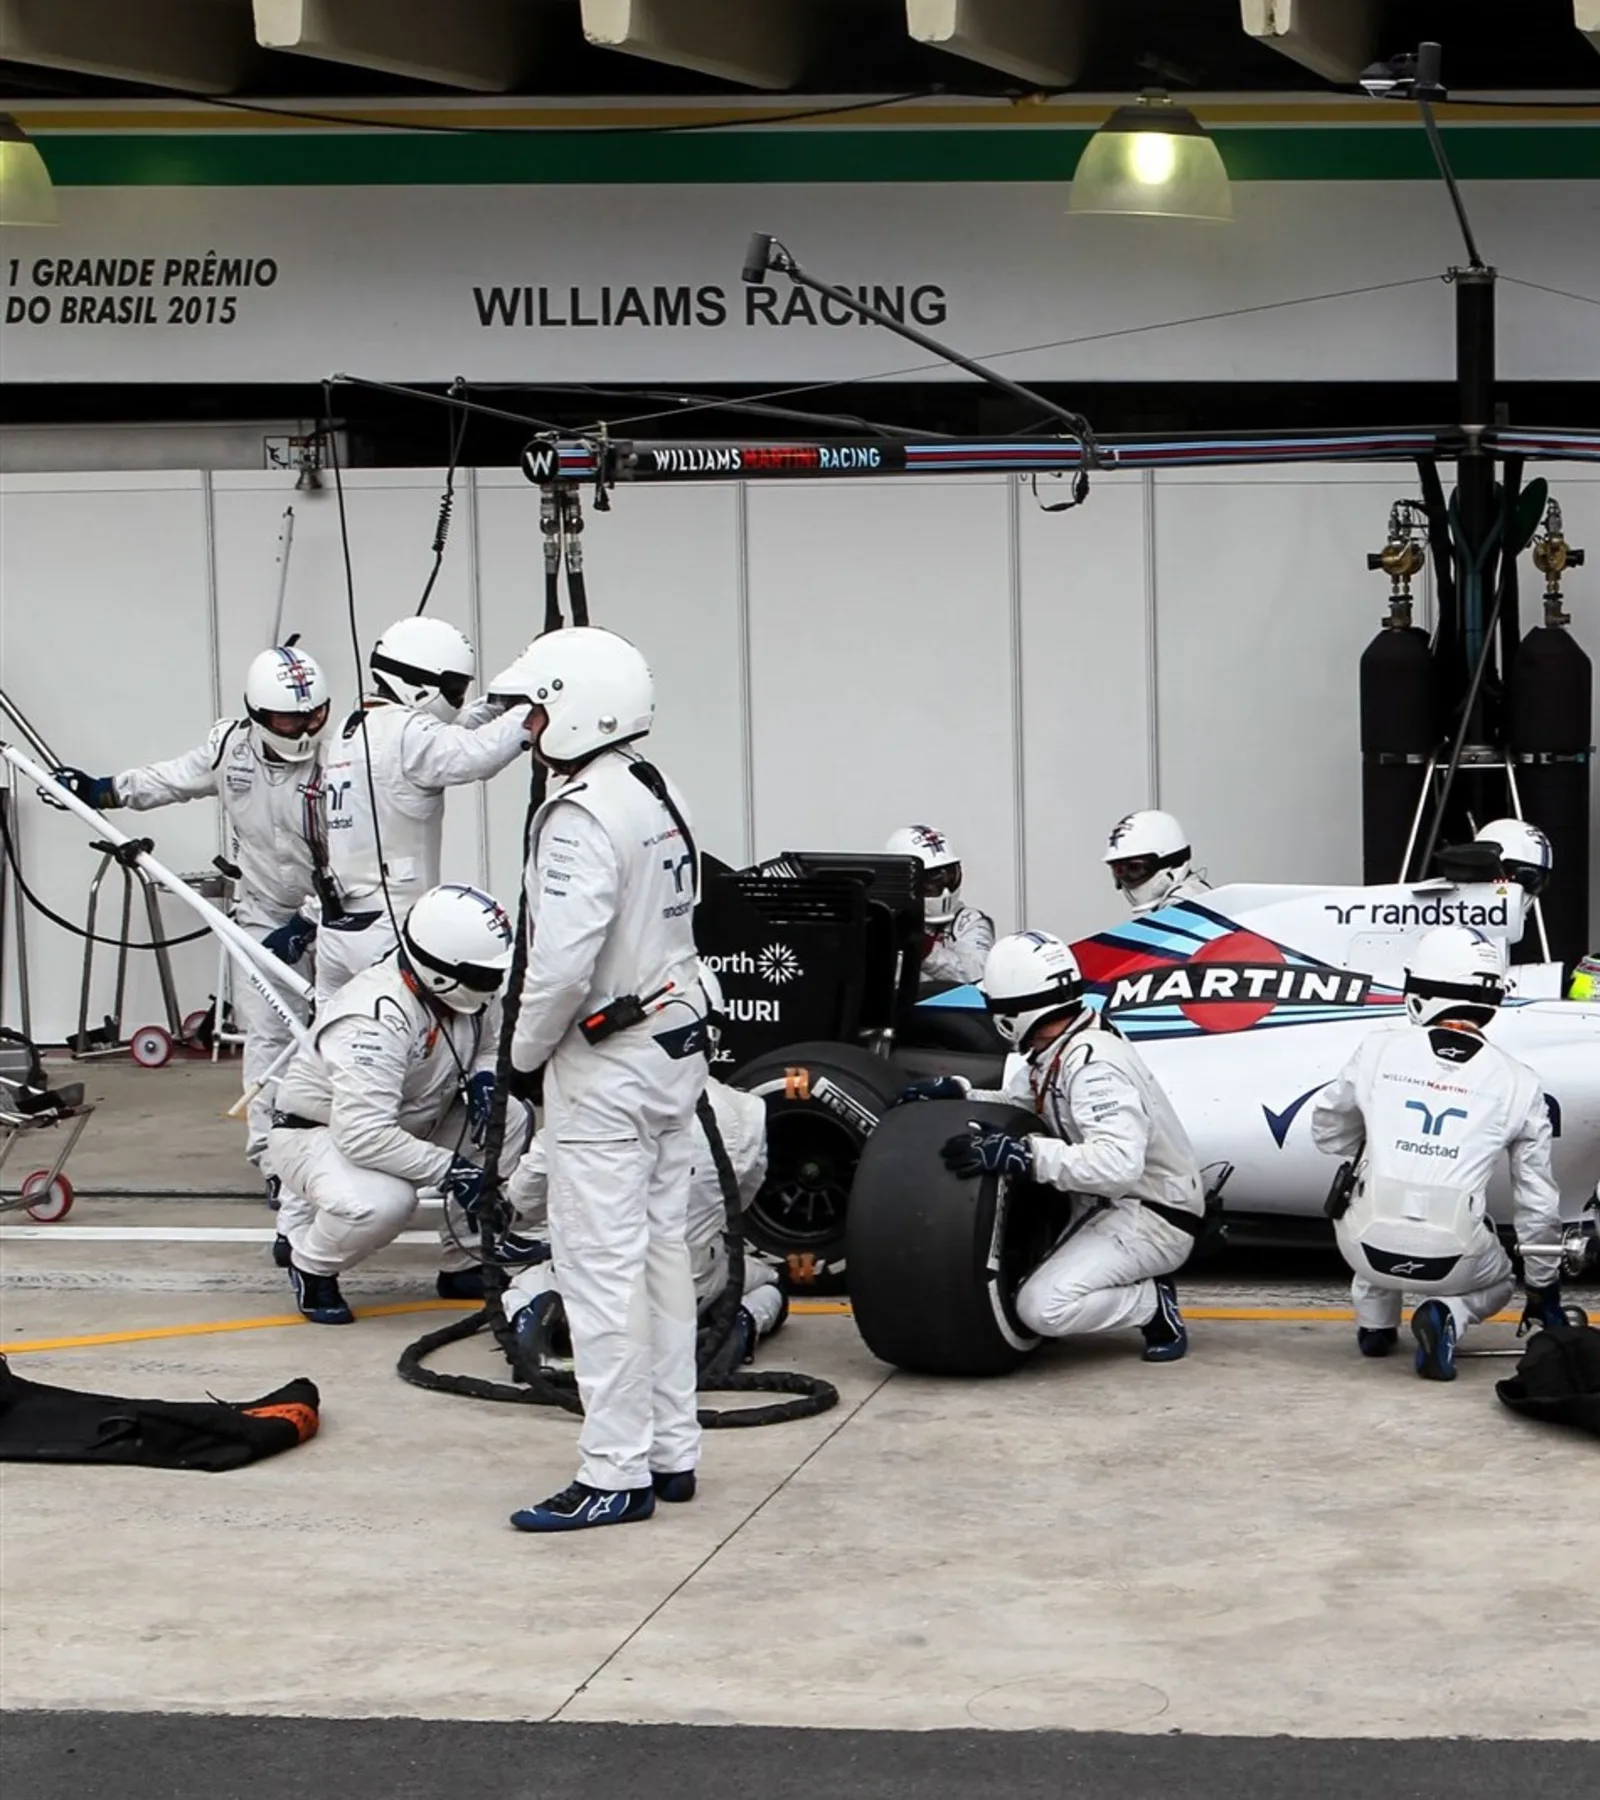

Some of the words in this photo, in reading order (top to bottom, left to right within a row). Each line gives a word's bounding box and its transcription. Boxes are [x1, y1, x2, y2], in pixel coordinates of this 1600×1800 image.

[9, 259, 19, 286] 1
[32, 258, 155, 287] GRANDE
[163, 249, 278, 287] PRÊMIO
[5, 296, 51, 324] DO
[60, 296, 158, 324] BRASIL
[167, 296, 237, 324] 2015
[473, 285, 727, 327] WILLIAMS
[745, 284, 947, 327] RACING
[526, 449, 554, 476] W
[1371, 898, 1508, 926] randstad
[1110, 969, 1366, 1007] MARTINI
[1396, 1139, 1461, 1160] randstad
